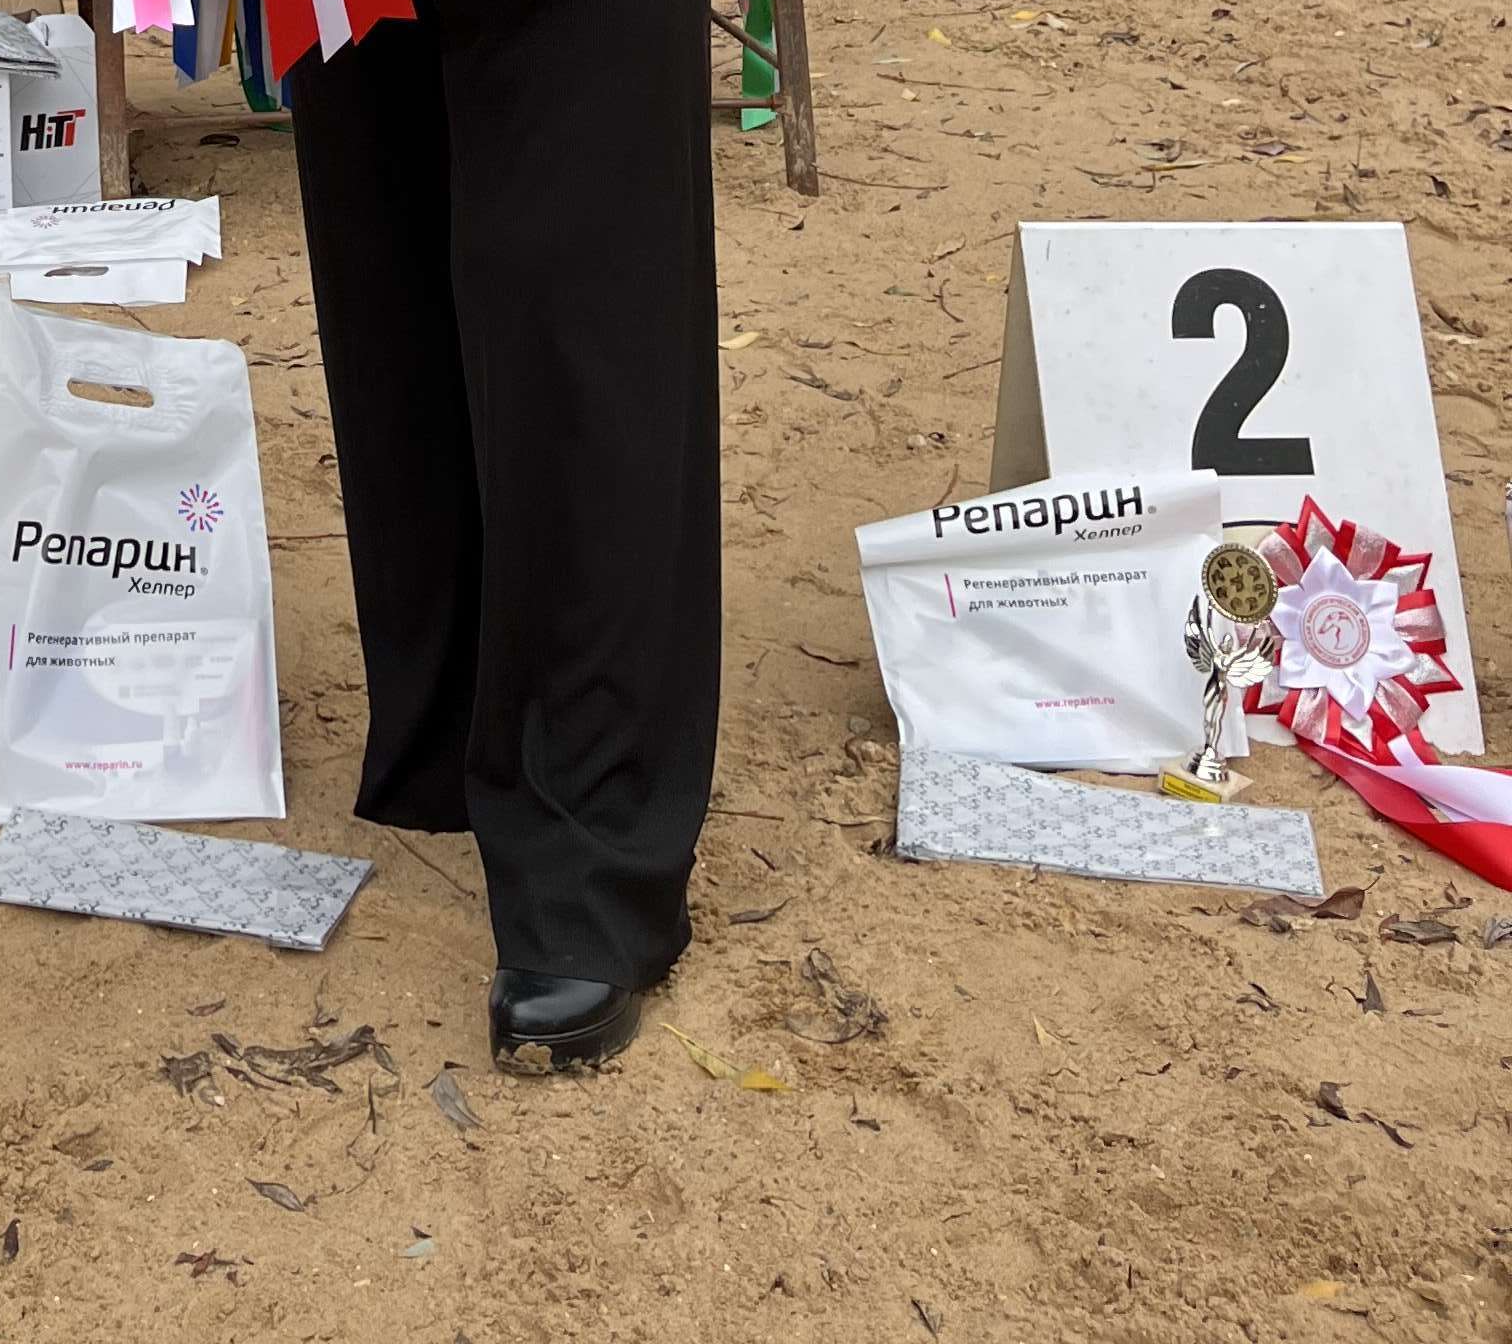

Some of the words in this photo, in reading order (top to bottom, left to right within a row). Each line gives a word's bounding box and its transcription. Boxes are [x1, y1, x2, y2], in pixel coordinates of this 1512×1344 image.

[1172, 268, 1315, 476] 2
[931, 485, 1144, 537] Репарин
[1074, 524, 1143, 543] Хелпер
[12, 520, 197, 579] Репарин
[128, 576, 196, 600] Хелпер
[963, 570, 1081, 591] Регенеративный
[1083, 568, 1148, 586] препарат
[968, 599, 994, 613] для
[996, 597, 1069, 610] животных
[27, 631, 131, 649] Регенеративный
[133, 631, 197, 645] препарат
[25, 655, 48, 667] для
[49, 656, 116, 667] животных
[1034, 696, 1116, 709] www.reparin.ru
[64, 759, 143, 772] www.reparin.ru
